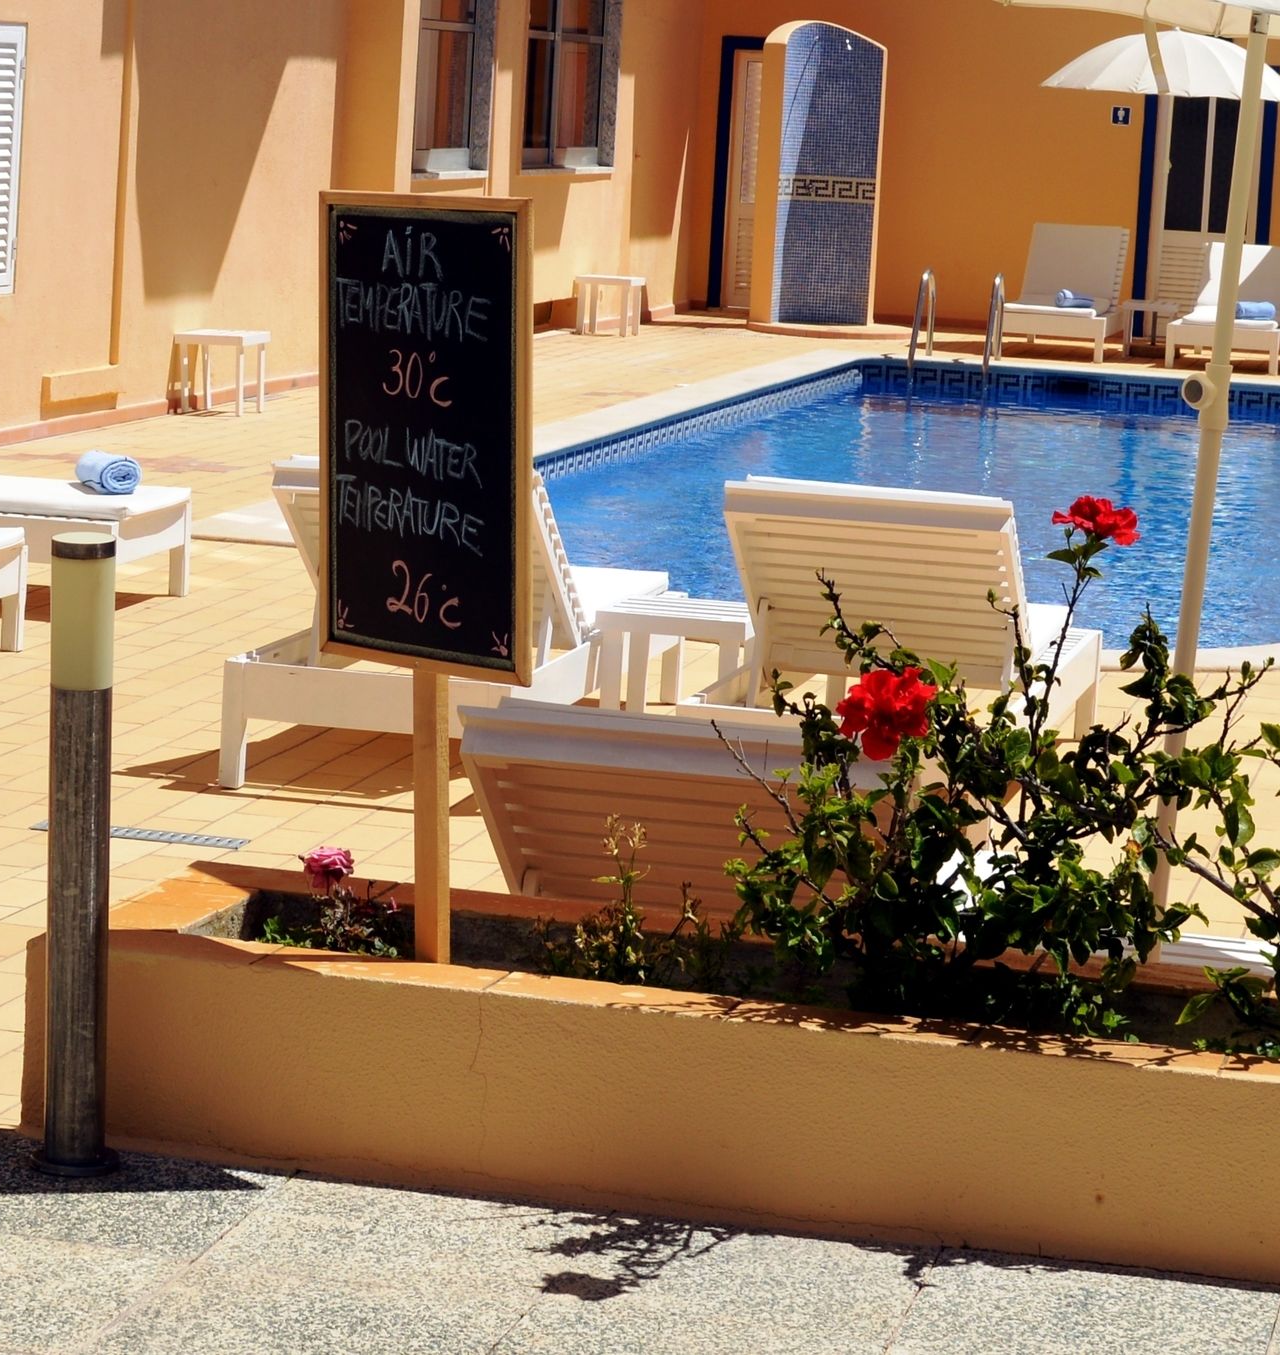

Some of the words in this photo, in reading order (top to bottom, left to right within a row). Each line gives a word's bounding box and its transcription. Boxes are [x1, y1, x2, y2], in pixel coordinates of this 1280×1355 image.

[335, 276, 492, 343] TEMPERATURE
[344, 419, 404, 468] POOL
[406, 426, 483, 489] WATER
[335, 473, 486, 557] TEMPERATURE
